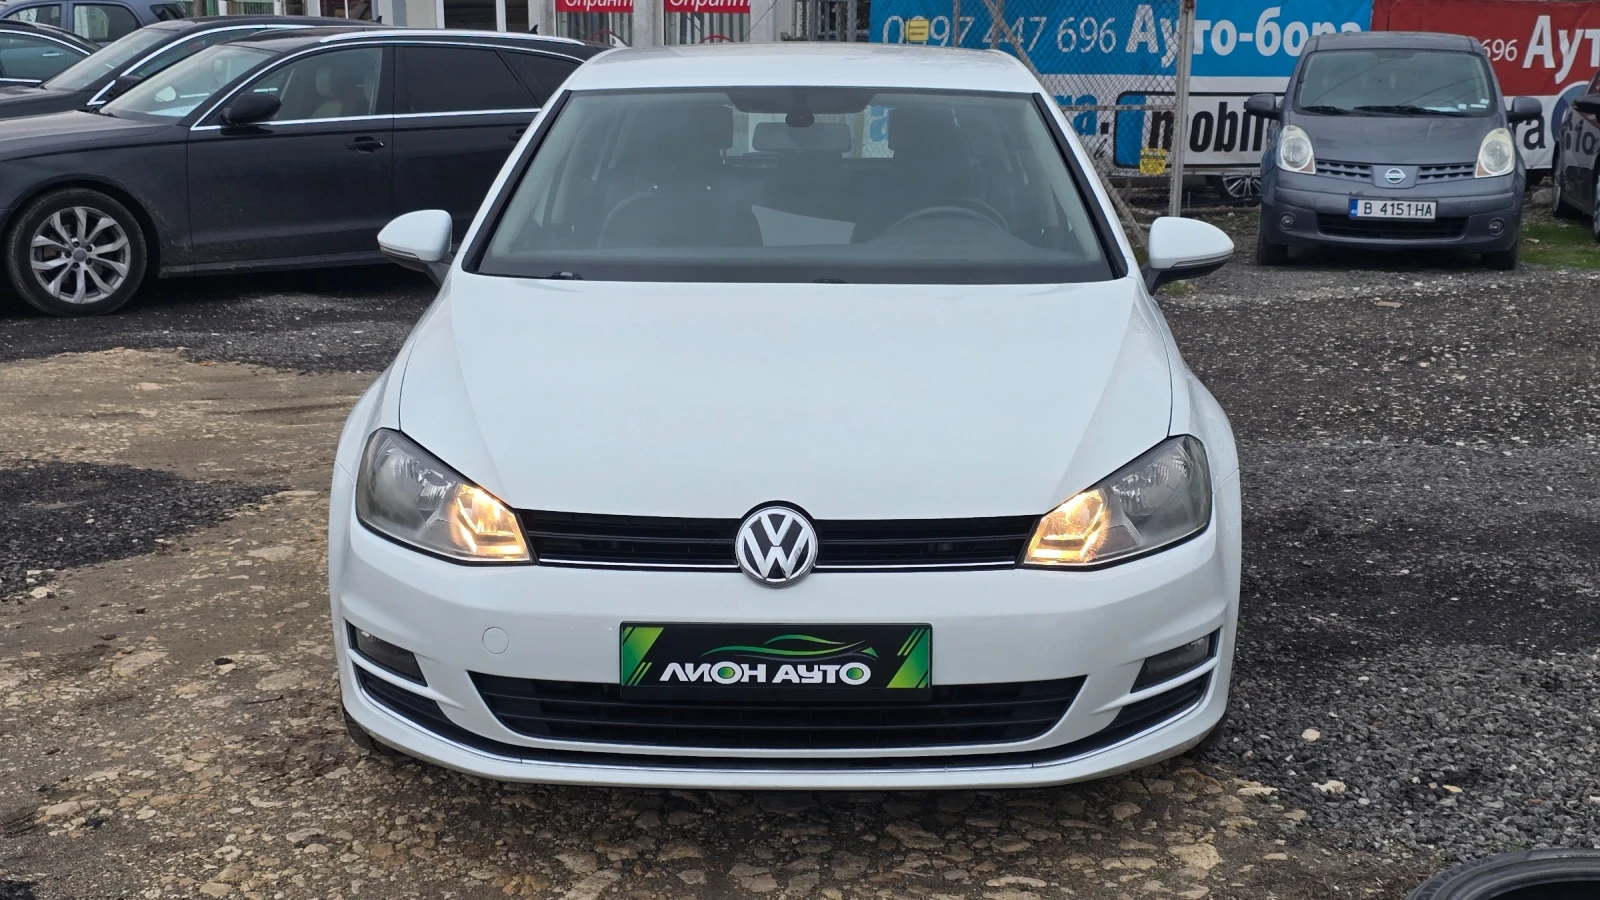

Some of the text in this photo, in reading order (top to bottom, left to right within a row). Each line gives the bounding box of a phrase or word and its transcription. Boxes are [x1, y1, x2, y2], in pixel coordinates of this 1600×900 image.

[882, 15, 975, 47] 097
[1057, 17, 1117, 54] 696
[659, 661, 871, 685] ЛИОН АУТО
